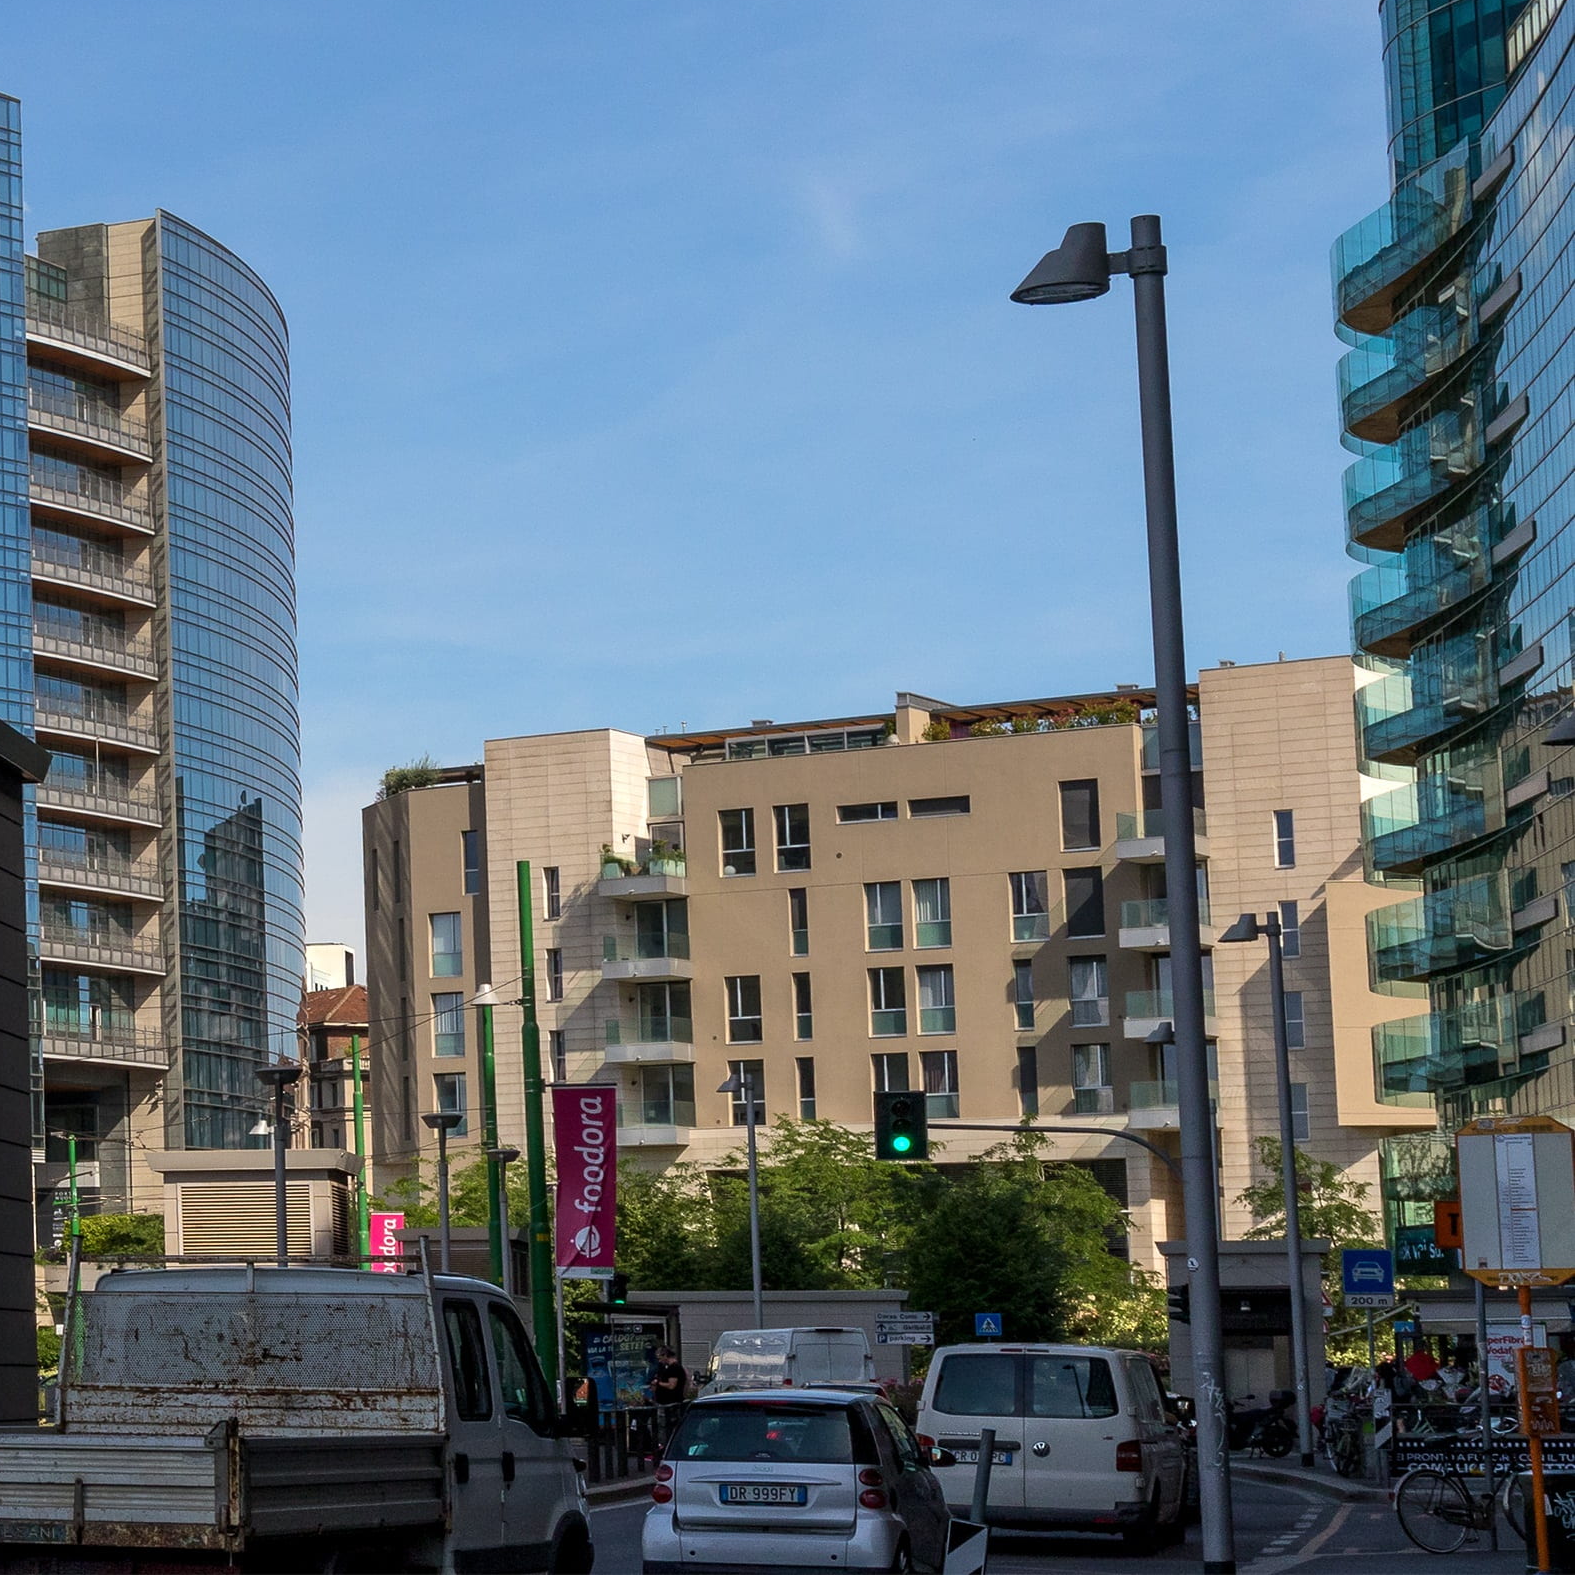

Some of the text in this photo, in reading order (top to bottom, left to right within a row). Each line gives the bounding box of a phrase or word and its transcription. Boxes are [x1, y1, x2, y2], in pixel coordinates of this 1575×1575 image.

[573, 1095, 605, 1214] foodora
[1351, 1296, 1388, 1305] 200 m
[889, 1334, 916, 1343] parking
[730, 1486, 797, 1501] DR 999FY
